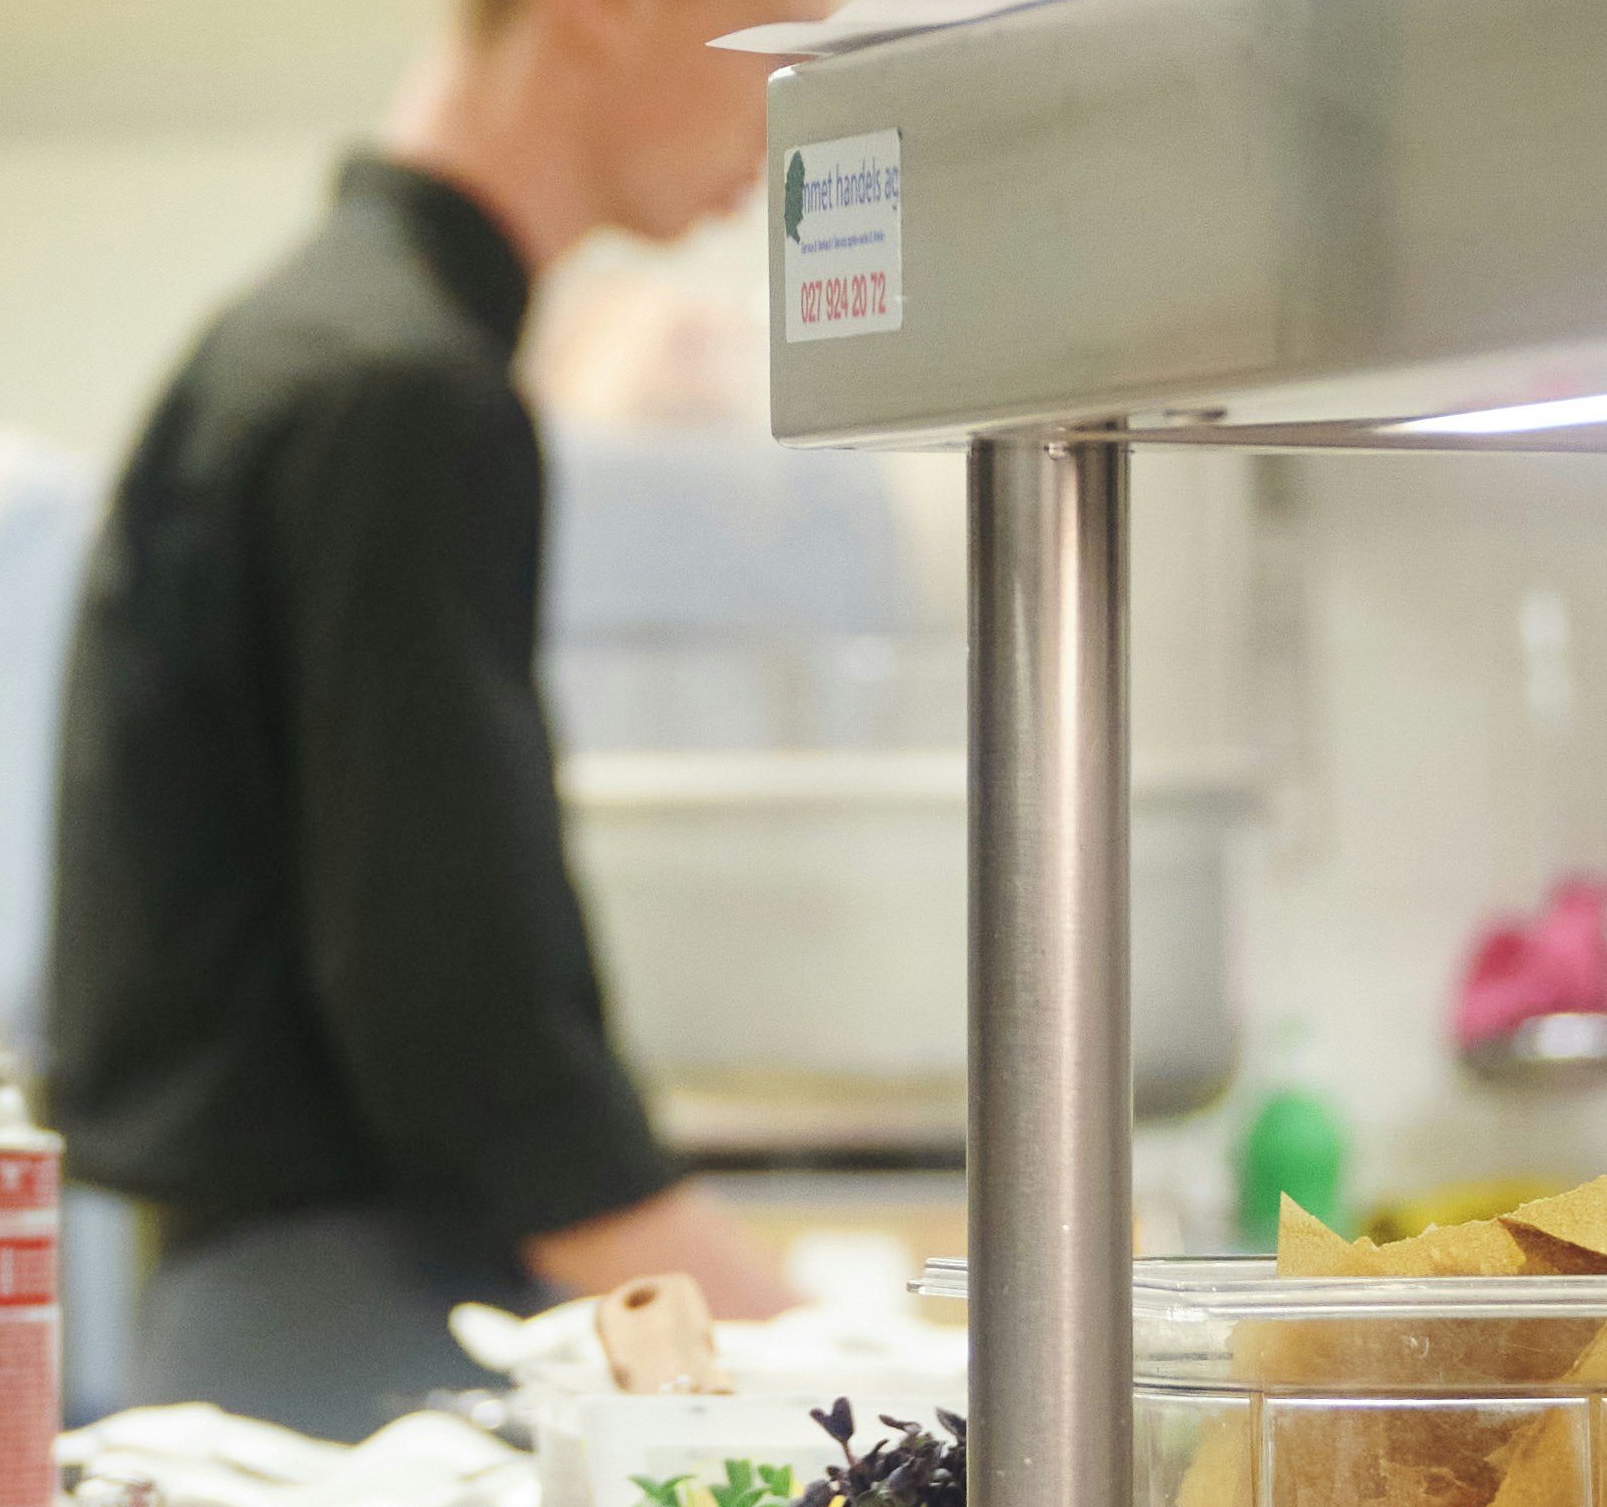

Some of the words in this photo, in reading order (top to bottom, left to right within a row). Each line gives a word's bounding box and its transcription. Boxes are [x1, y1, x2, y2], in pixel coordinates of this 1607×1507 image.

[836, 156, 882, 207] handels
[801, 280, 823, 323] 027
[826, 276, 849, 321] 924
[851, 273, 867, 317] 20
[870, 271, 887, 315] 72
